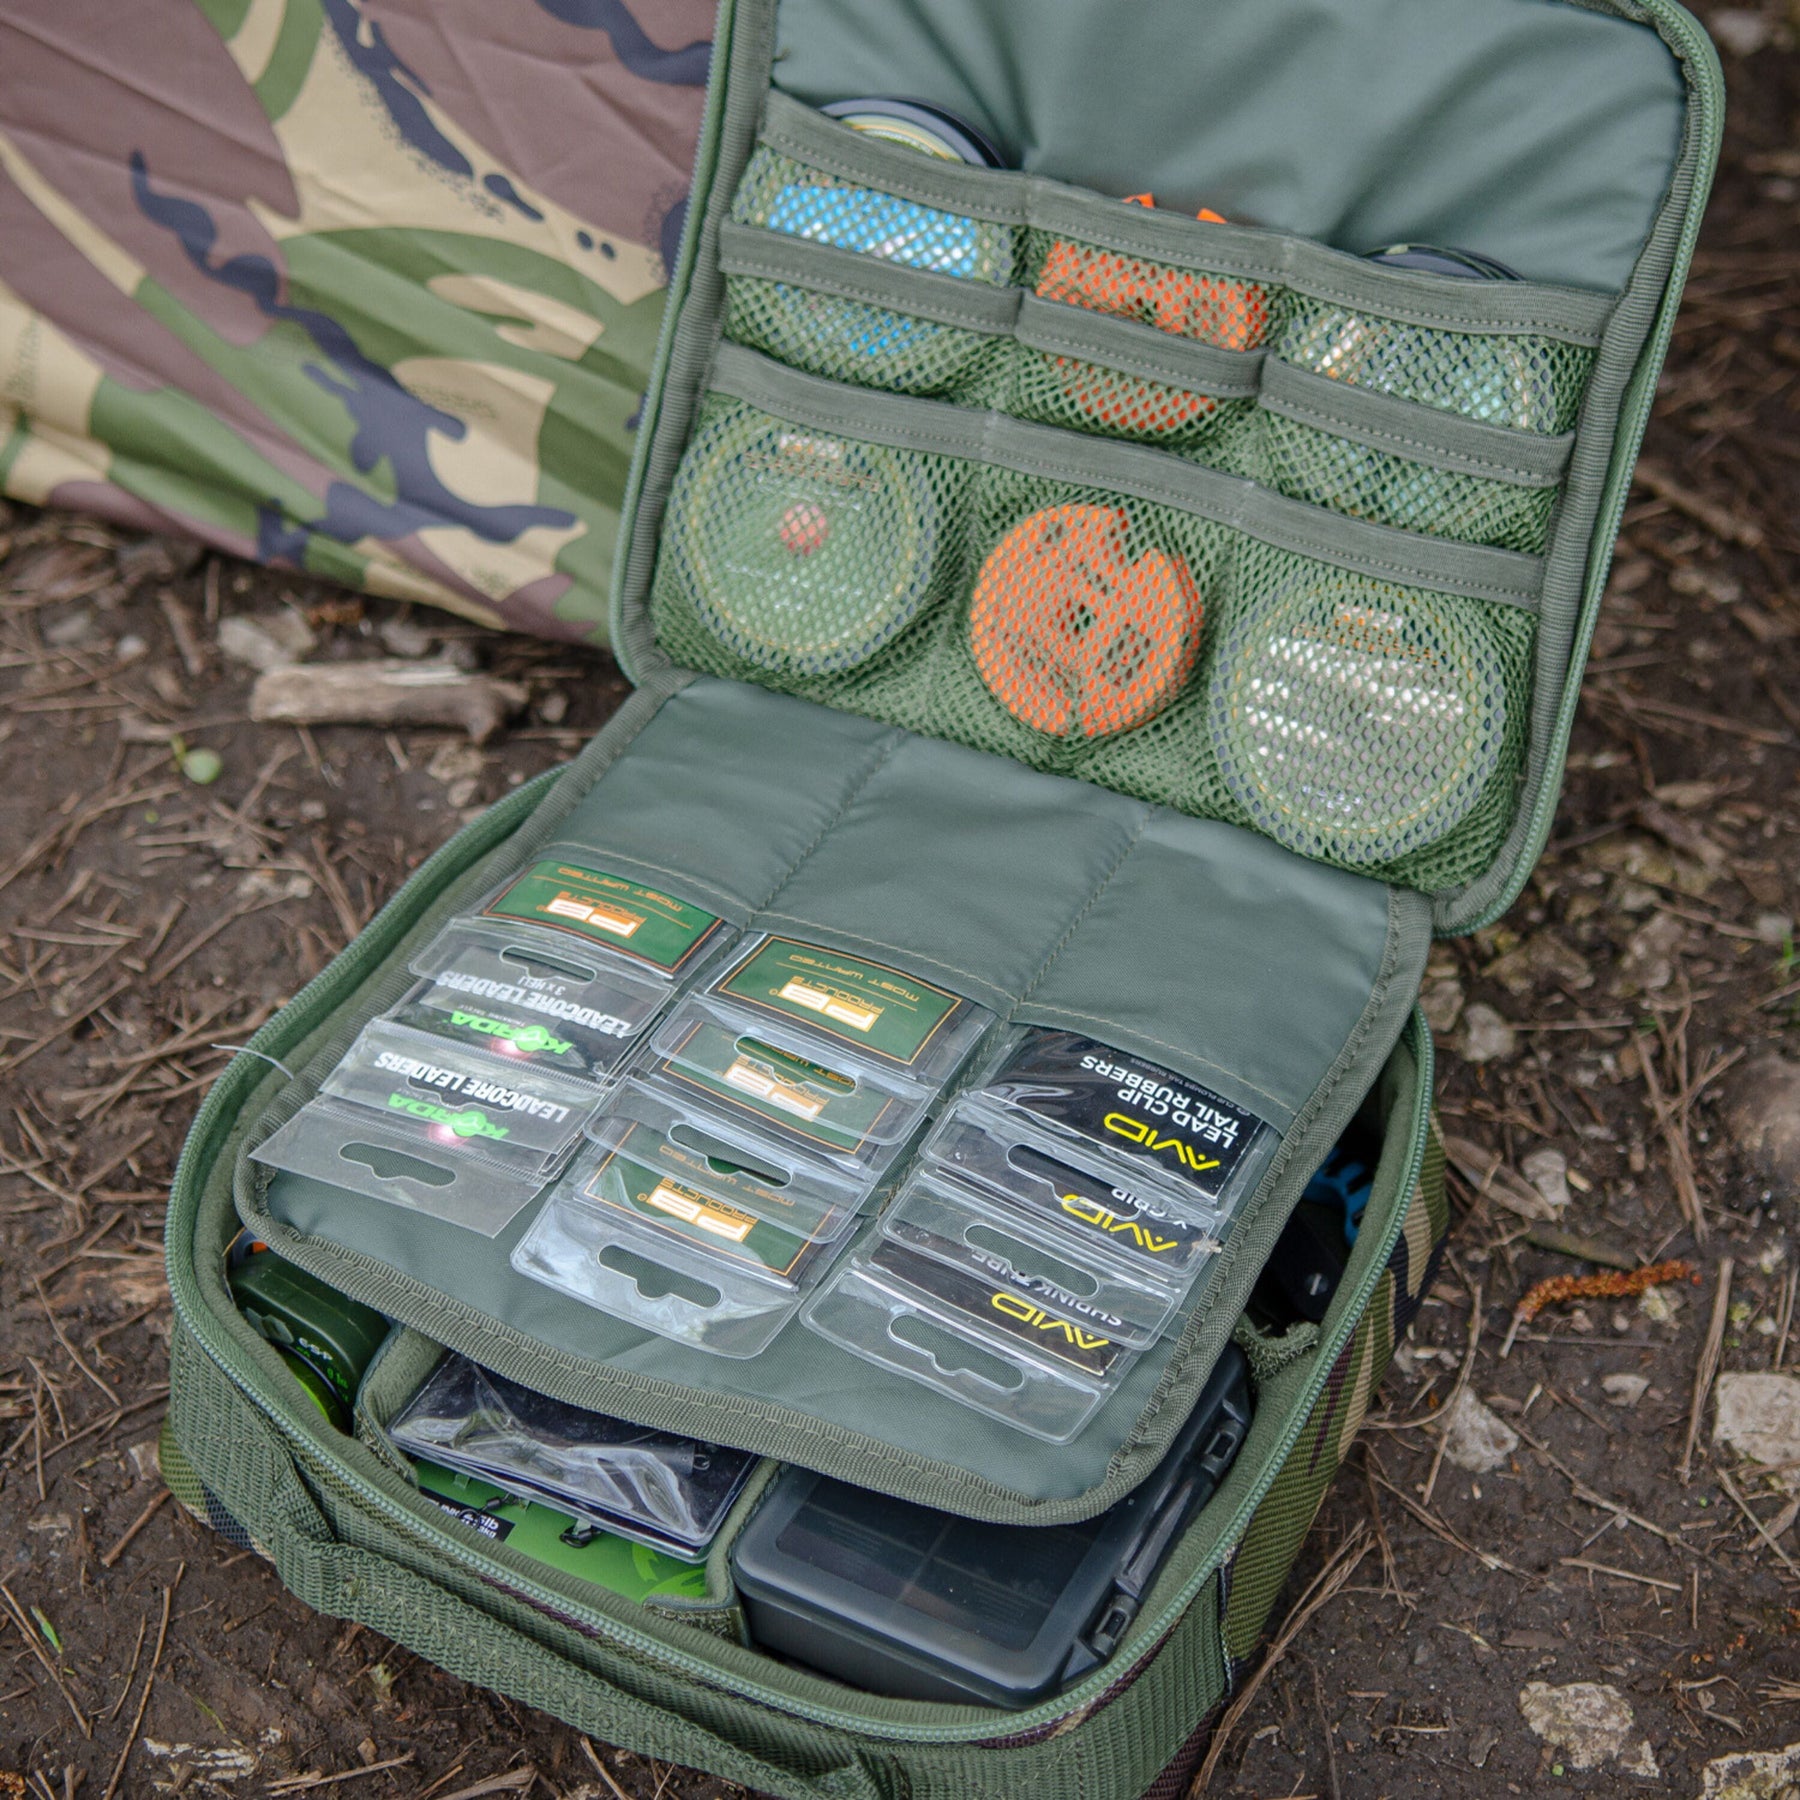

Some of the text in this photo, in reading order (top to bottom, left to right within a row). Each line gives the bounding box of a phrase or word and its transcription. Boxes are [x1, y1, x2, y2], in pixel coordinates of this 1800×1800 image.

[557, 891, 647, 925] PRODUCTS
[558, 867, 683, 912] MOST WANTED
[546, 898, 641, 938] PB
[517, 976, 546, 991] HELI
[554, 986, 567, 996] 3
[789, 954, 920, 1002] MOST WANTED
[789, 975, 885, 1015] PRODUCTS
[436, 971, 632, 1039] LEADCORE LEADERS
[777, 982, 880, 1032] PB
[450, 1010, 573, 1055] KORDA
[374, 1051, 571, 1123] LEADCORE LEADERS
[1079, 1055, 1240, 1136] TAIL RUBBERS
[1104, 1112, 1220, 1171] AVID
[1117, 1088, 1235, 1149] LEAD CLIP
[659, 1145, 796, 1207] MOST WANTED
[660, 1177, 760, 1225] PRODUCTS
[646, 1185, 755, 1243] PB
[1061, 1194, 1178, 1252] AVID
[992, 1293, 1110, 1350] AVID
